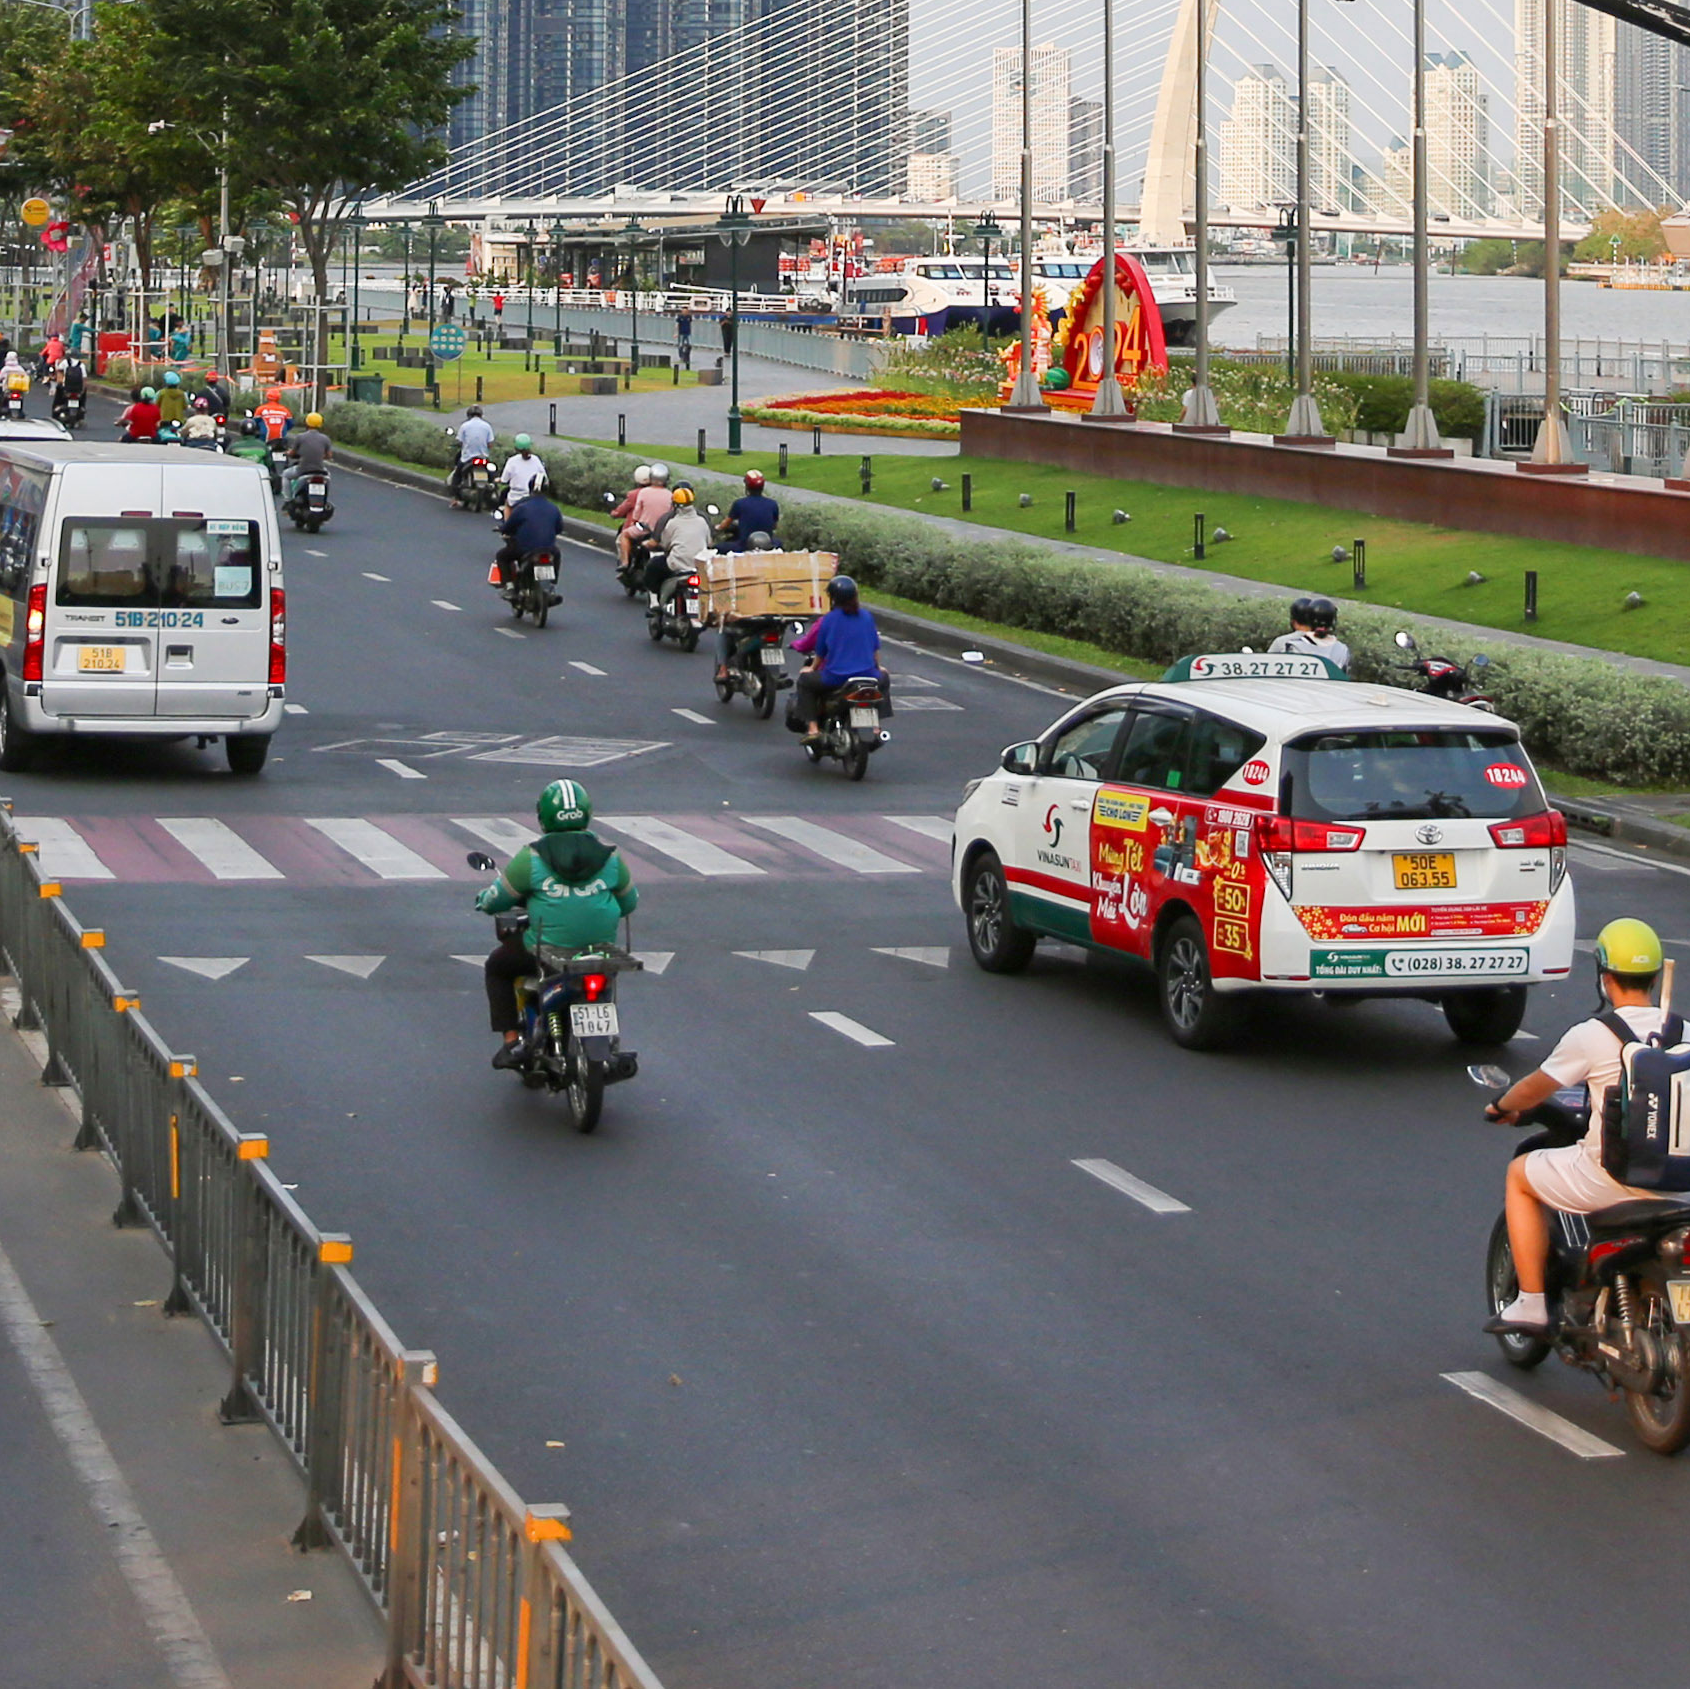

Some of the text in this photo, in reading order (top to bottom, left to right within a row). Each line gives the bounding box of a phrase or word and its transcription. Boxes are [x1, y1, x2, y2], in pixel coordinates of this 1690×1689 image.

[64, 614, 106, 622] TRANSIT
[83, 659, 120, 669] 210.24
[1276, 662, 1294, 675] 27
[1301, 662, 1320, 676] 27
[1243, 762, 1270, 782] 18244
[1486, 767, 1526, 785] 18244
[556, 808, 584, 821] Grab
[1410, 856, 1437, 870] 50E
[1401, 871, 1451, 887] 063.55
[1339, 913, 1357, 923] Đón
[1375, 913, 1395, 923] năm
[1369, 923, 1382, 933] Cơ
[1396, 913, 1426, 933] MỚI
[1407, 956, 1523, 972] (028) 38. 27 27 27
[577, 1005, 610, 1020] 51-L6
[580, 1020, 610, 1034] 1047
[1646, 1110, 1659, 1140] YONEX
